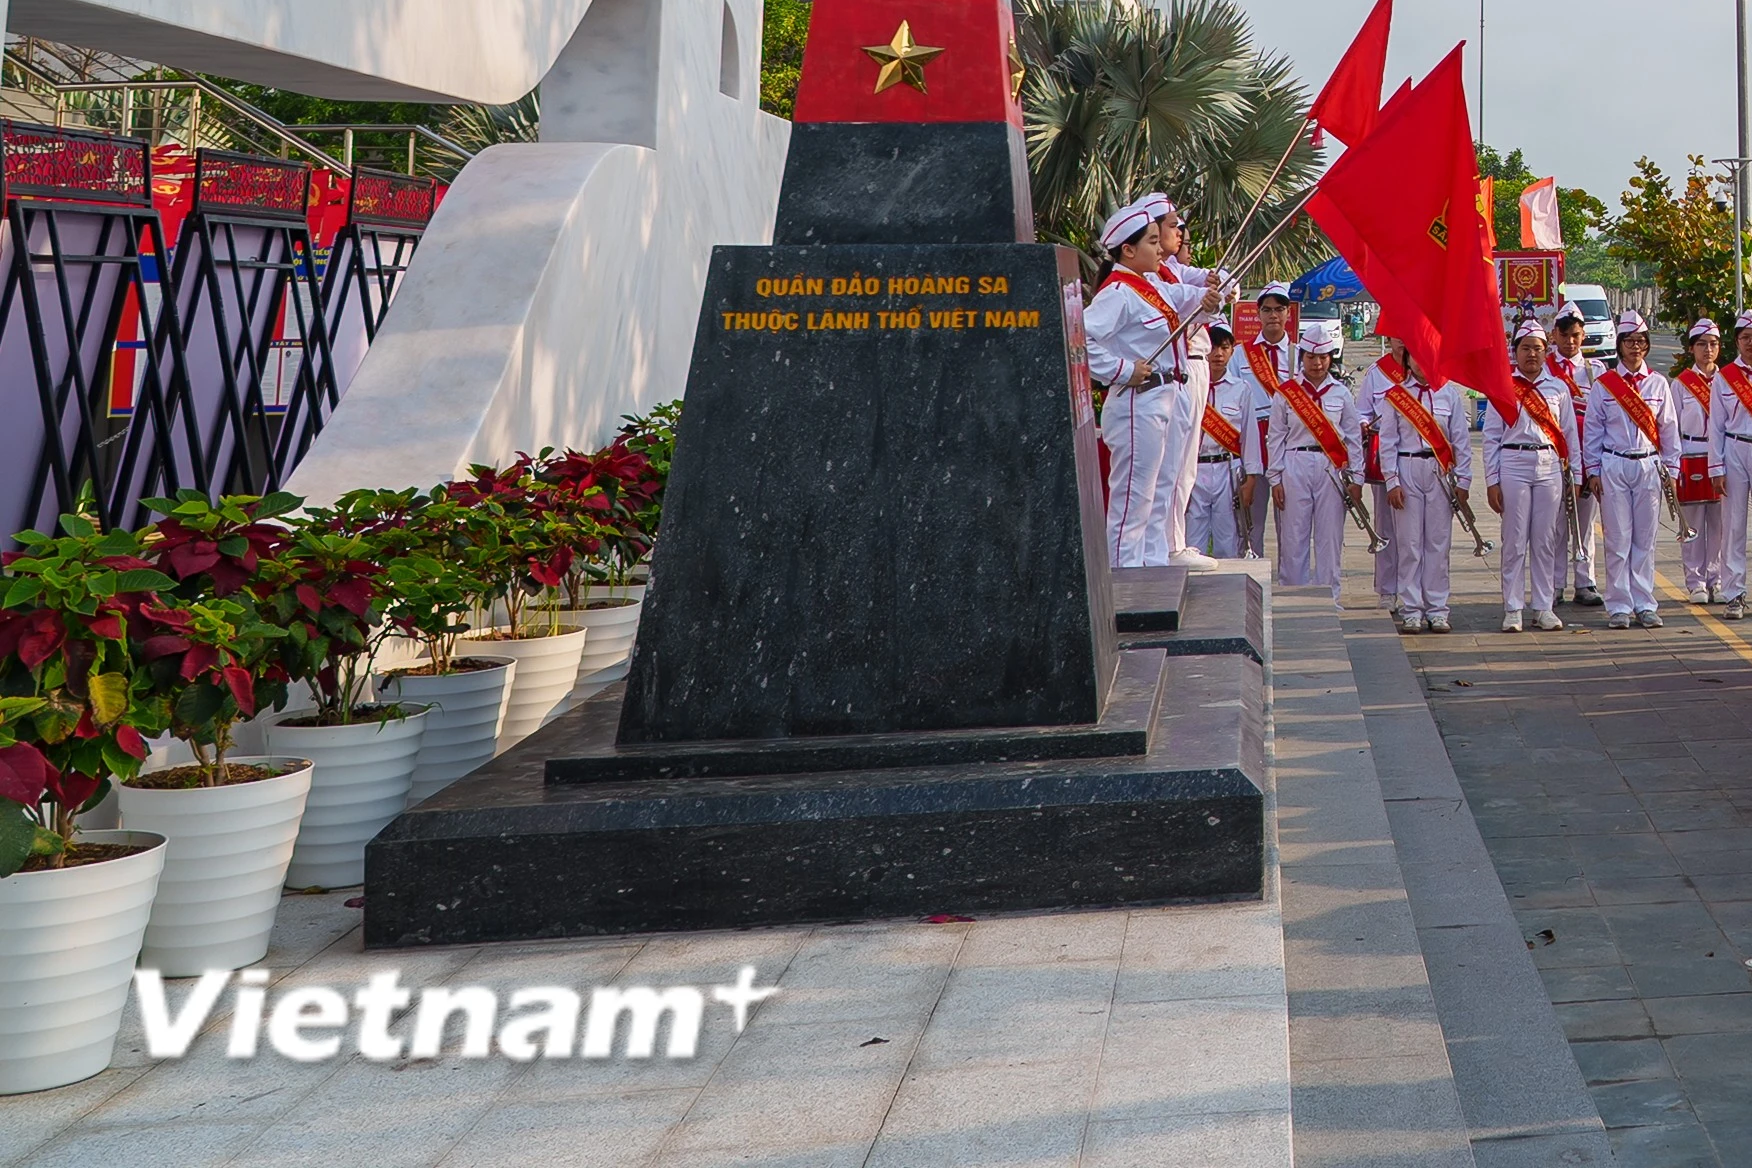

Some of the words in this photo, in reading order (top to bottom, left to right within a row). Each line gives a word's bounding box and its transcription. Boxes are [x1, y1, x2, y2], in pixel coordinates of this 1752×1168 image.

[831, 271, 881, 296] ĐẢO
[888, 272, 970, 295] HOÀNG
[978, 276, 1009, 295] SA
[722, 308, 799, 334] THUỘC
[807, 308, 870, 330] LÃNH
[877, 304, 924, 329] THỔ
[929, 306, 978, 331] VIỆT
[985, 311, 1040, 328] NAM
